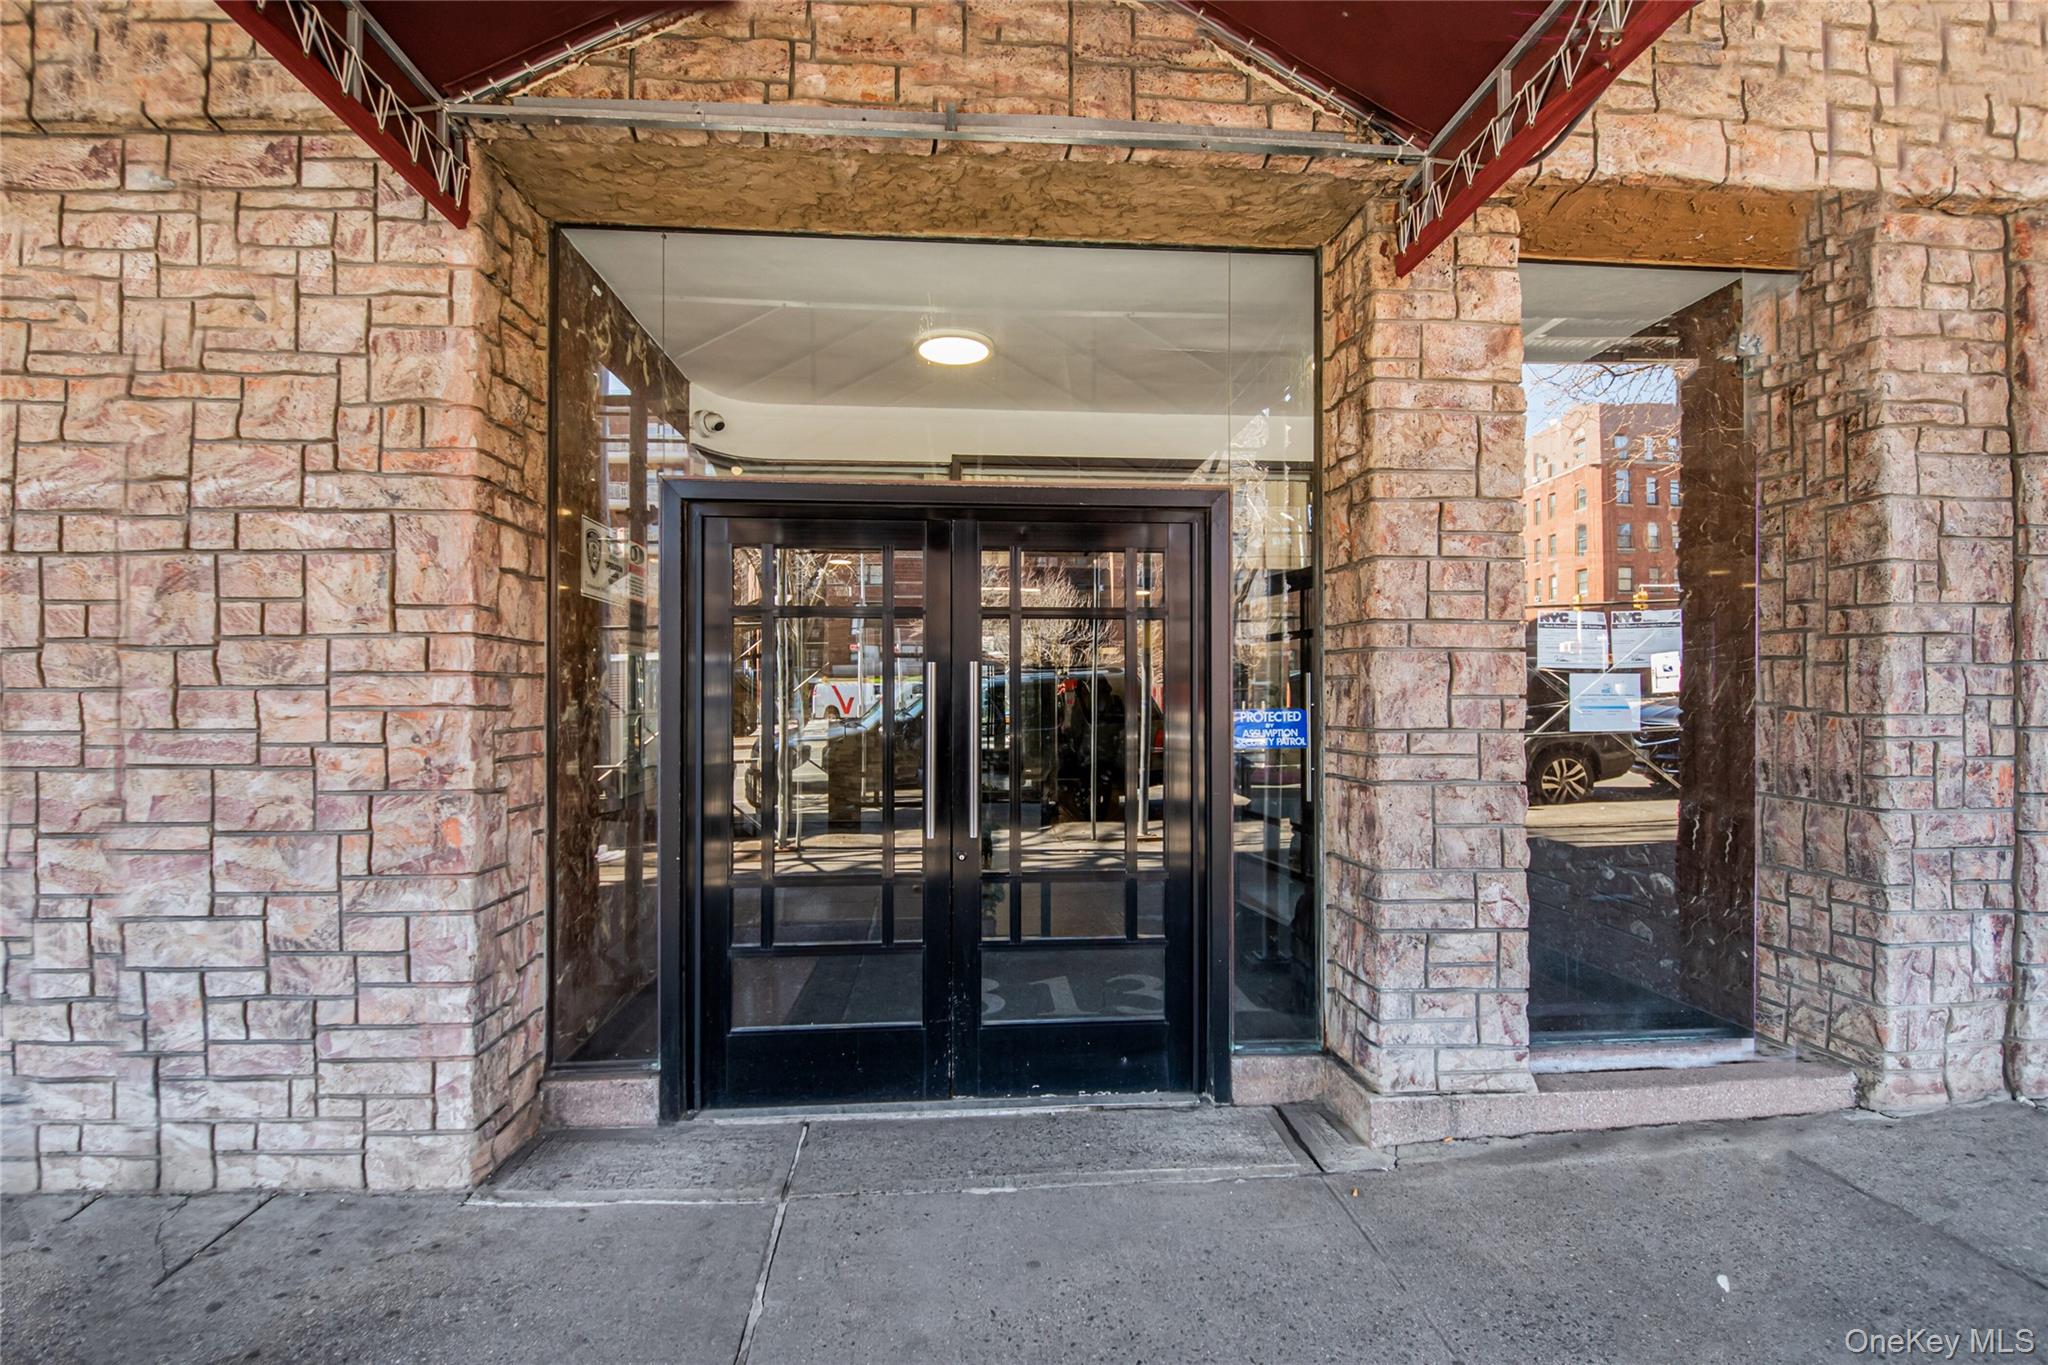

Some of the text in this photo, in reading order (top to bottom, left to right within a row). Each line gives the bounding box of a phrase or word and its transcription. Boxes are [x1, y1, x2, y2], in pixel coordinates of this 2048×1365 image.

[1540, 612, 1569, 622] NYC
[1613, 612, 1642, 622] NYC
[1240, 711, 1302, 722] PROTECTED
[1241, 729, 1298, 737] ASSUMPTION
[1236, 737, 1307, 746] SECUTY PATROL
